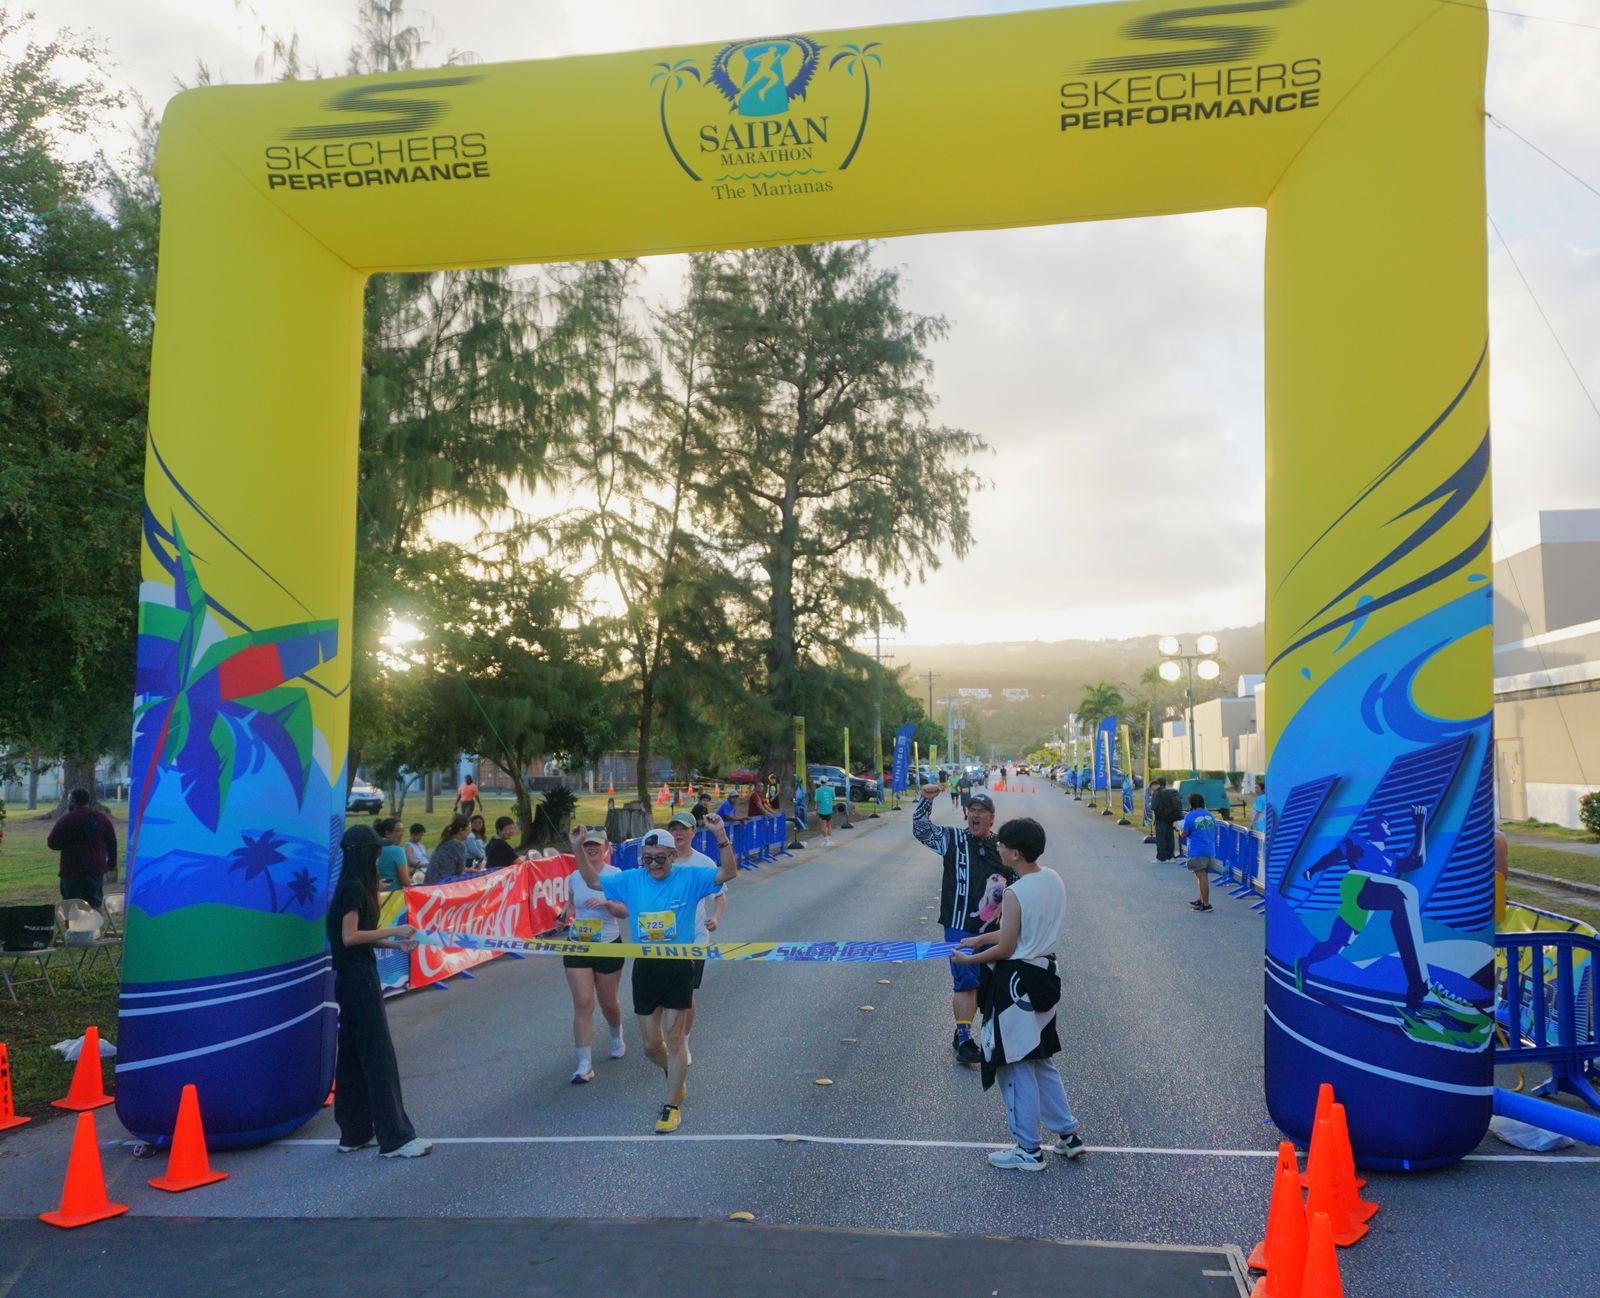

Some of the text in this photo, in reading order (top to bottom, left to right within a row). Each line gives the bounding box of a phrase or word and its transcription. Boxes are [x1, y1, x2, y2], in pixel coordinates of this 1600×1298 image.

[1060, 58, 1321, 109] SKECHERS
[1061, 88, 1320, 131] PERFORMANCE
[699, 115, 829, 153] SAIPAN
[265, 132, 488, 171] SKECHERS
[720, 147, 813, 167] MARATHON
[267, 161, 490, 190] PERFORMANCE
[712, 179, 833, 200] The Marianas
[646, 921, 664, 930] 725
[484, 938, 891, 958] SKECHERS FINISH SKECHERS
